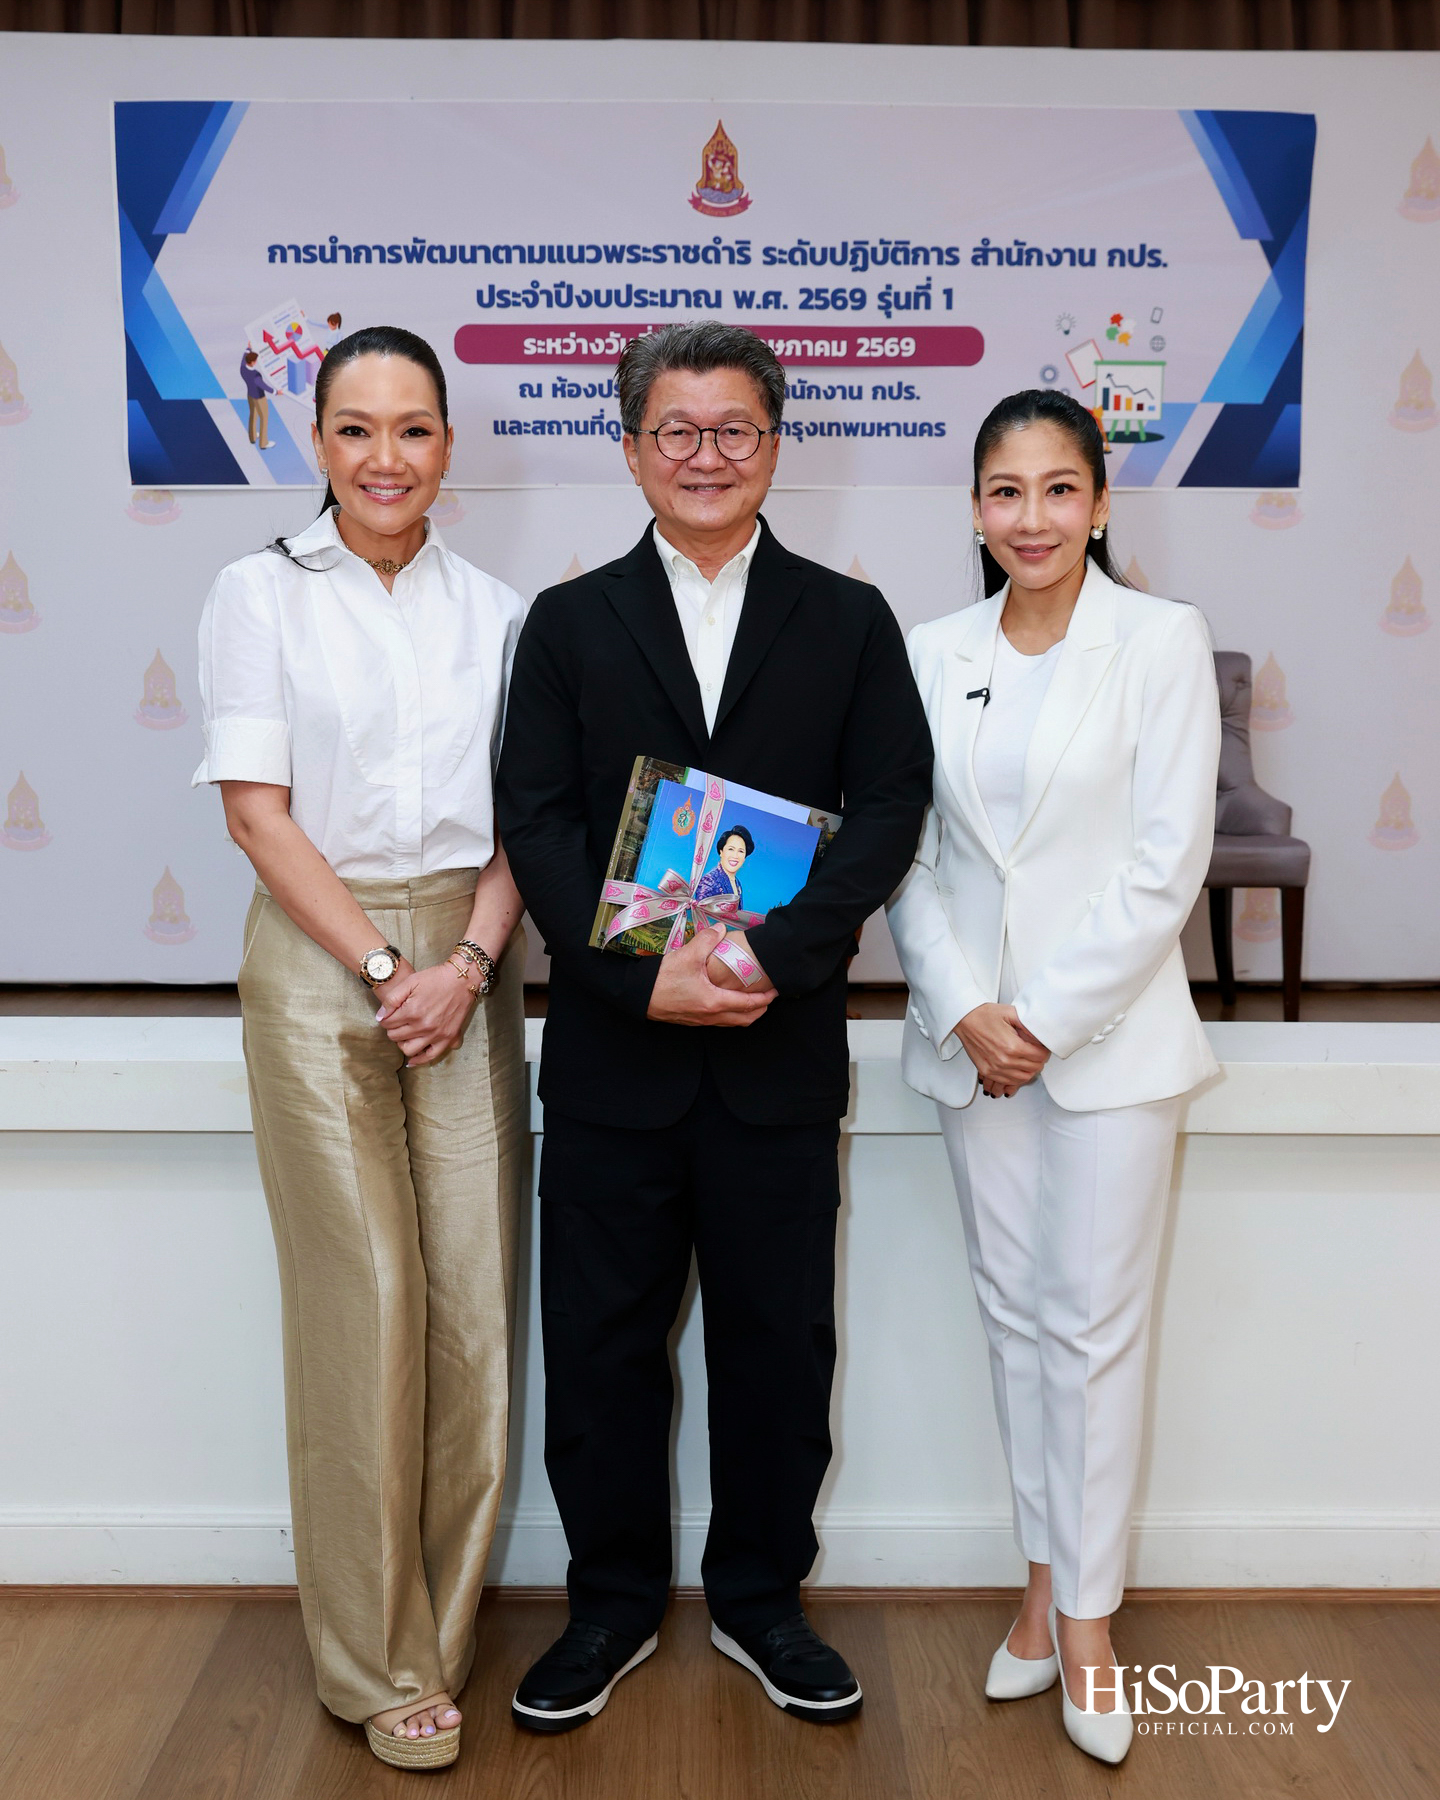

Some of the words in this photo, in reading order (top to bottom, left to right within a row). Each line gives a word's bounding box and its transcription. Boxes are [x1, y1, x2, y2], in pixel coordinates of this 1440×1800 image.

[267, 235, 752, 265] การนำการพัฒนาตามแนวพระราชดำริ
[762, 238, 960, 272] ระดับปฏิบัติการ
[970, 238, 1097, 267] สำนักงาน
[1107, 244, 1169, 268] กปร.
[476, 279, 722, 309] ประจำปีงบประมาณ
[732, 290, 789, 310] พ.ศ.
[798, 287, 867, 310] 2569
[877, 276, 932, 319] รุ่นที่
[942, 287, 954, 310] 1
[760, 338, 848, 358] ษภาคม
[856, 337, 916, 358] 2569
[518, 382, 544, 399] ณ
[871, 380, 921, 400] กปร.
[778, 421, 947, 443] กรุงเทพมหานคร
